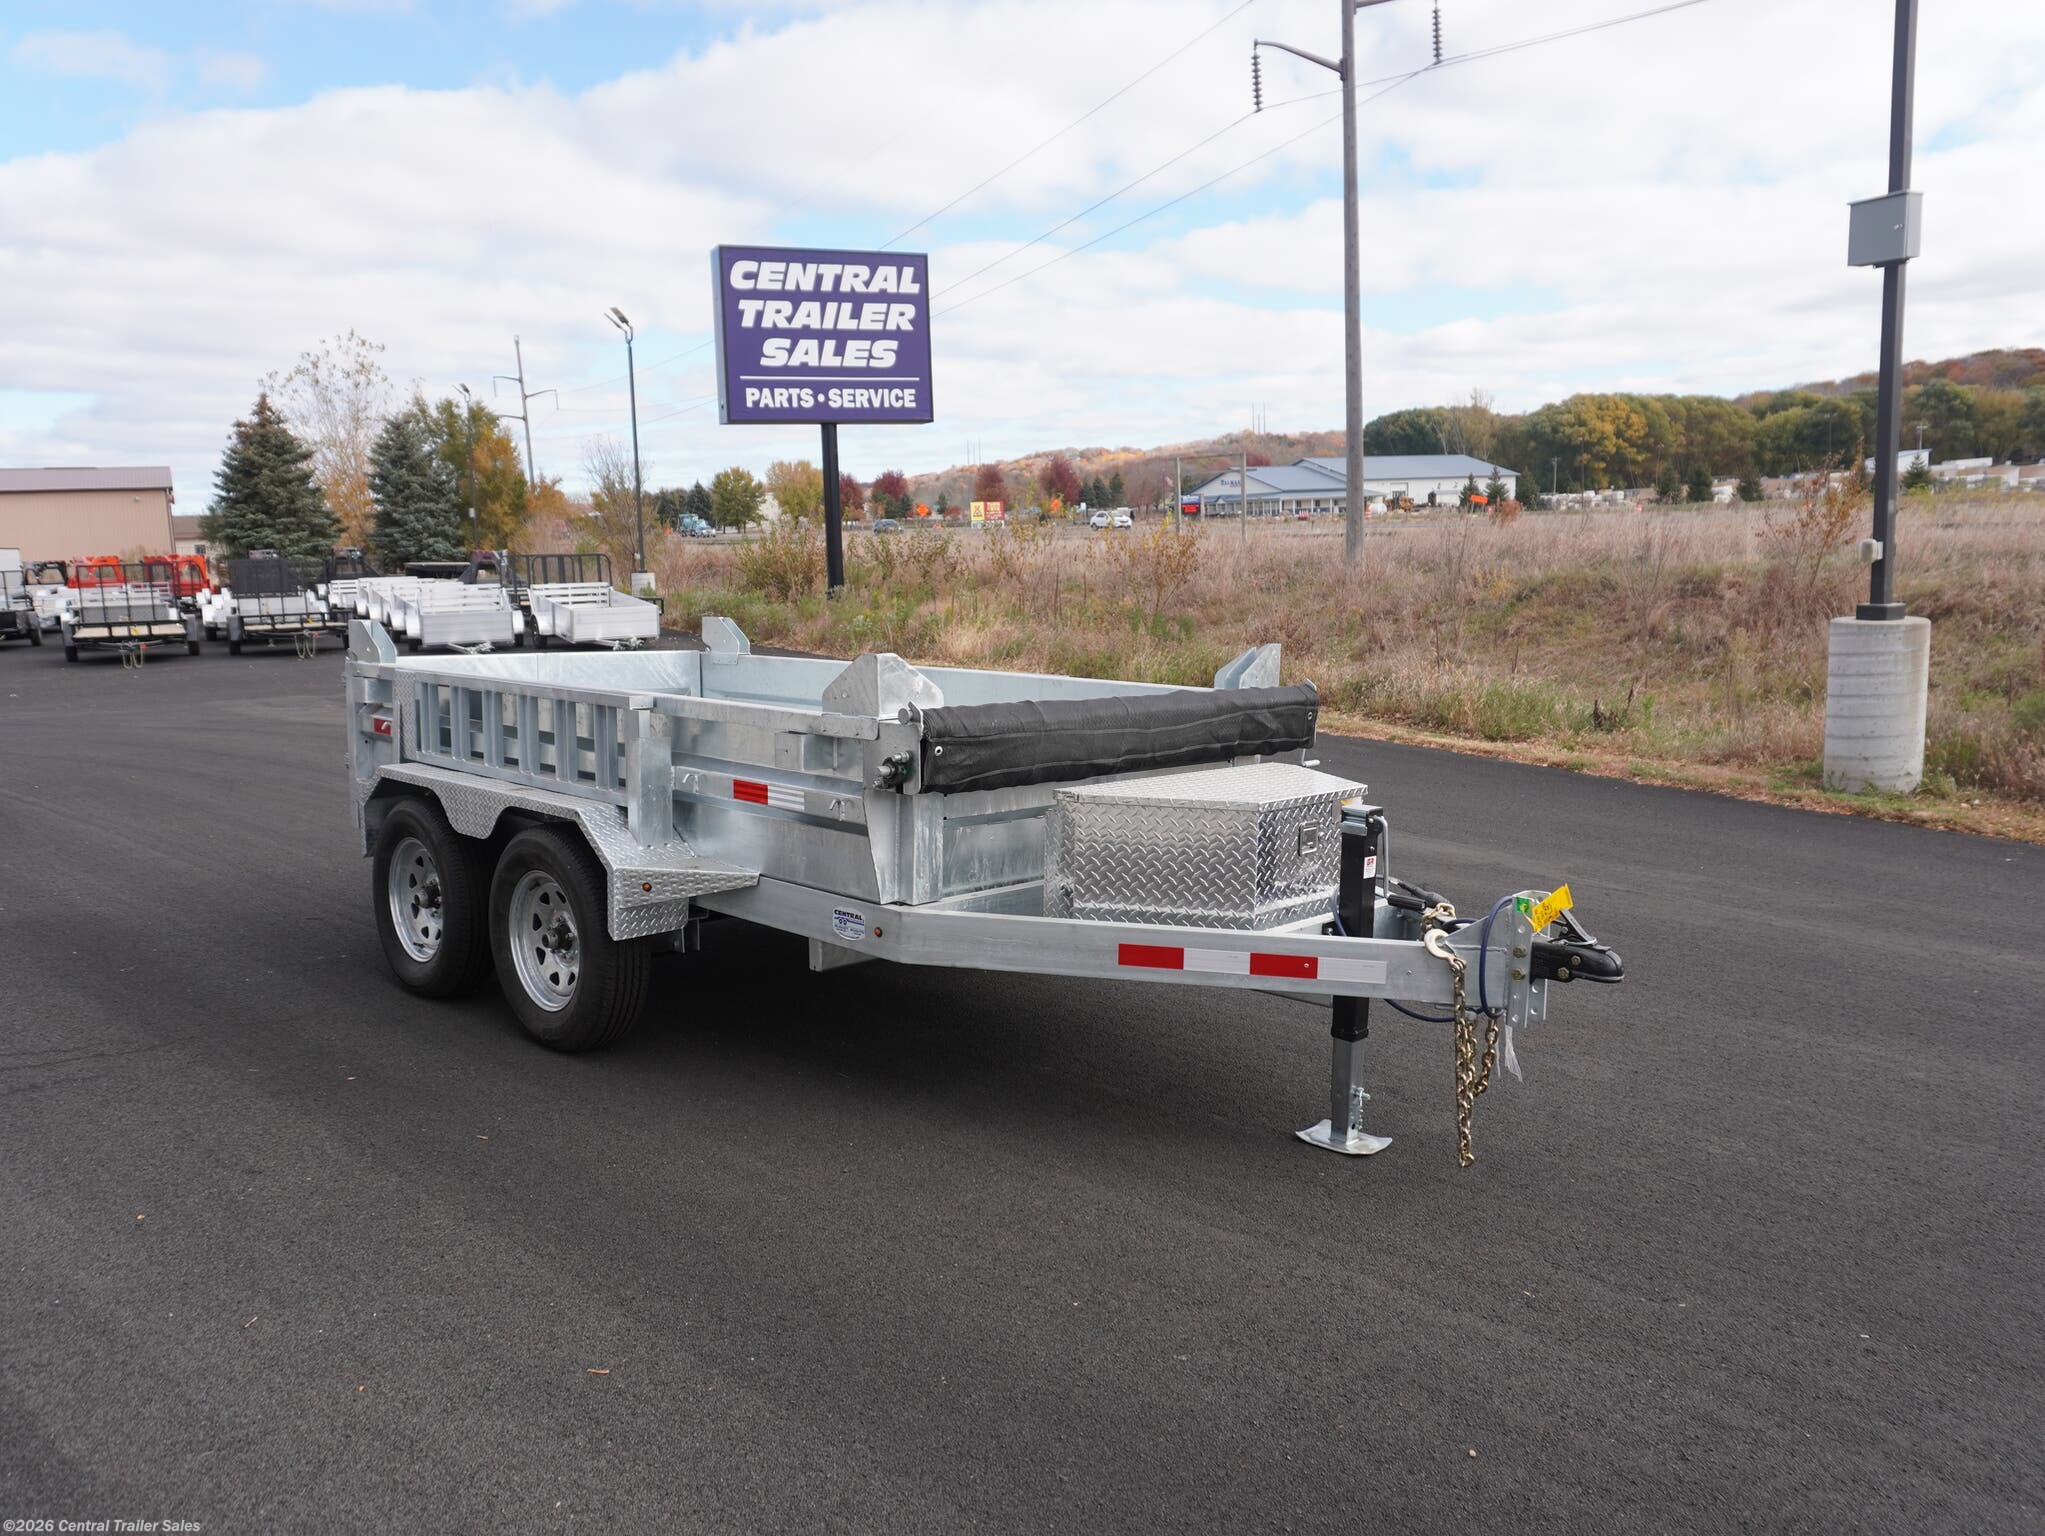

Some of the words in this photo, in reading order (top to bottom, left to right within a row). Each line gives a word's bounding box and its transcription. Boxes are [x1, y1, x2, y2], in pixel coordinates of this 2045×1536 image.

[730, 260, 920, 294] CENTRAL
[738, 299, 916, 331] TRAILER
[759, 337, 899, 368] SALES
[834, 909, 863, 921] CENTRAL
